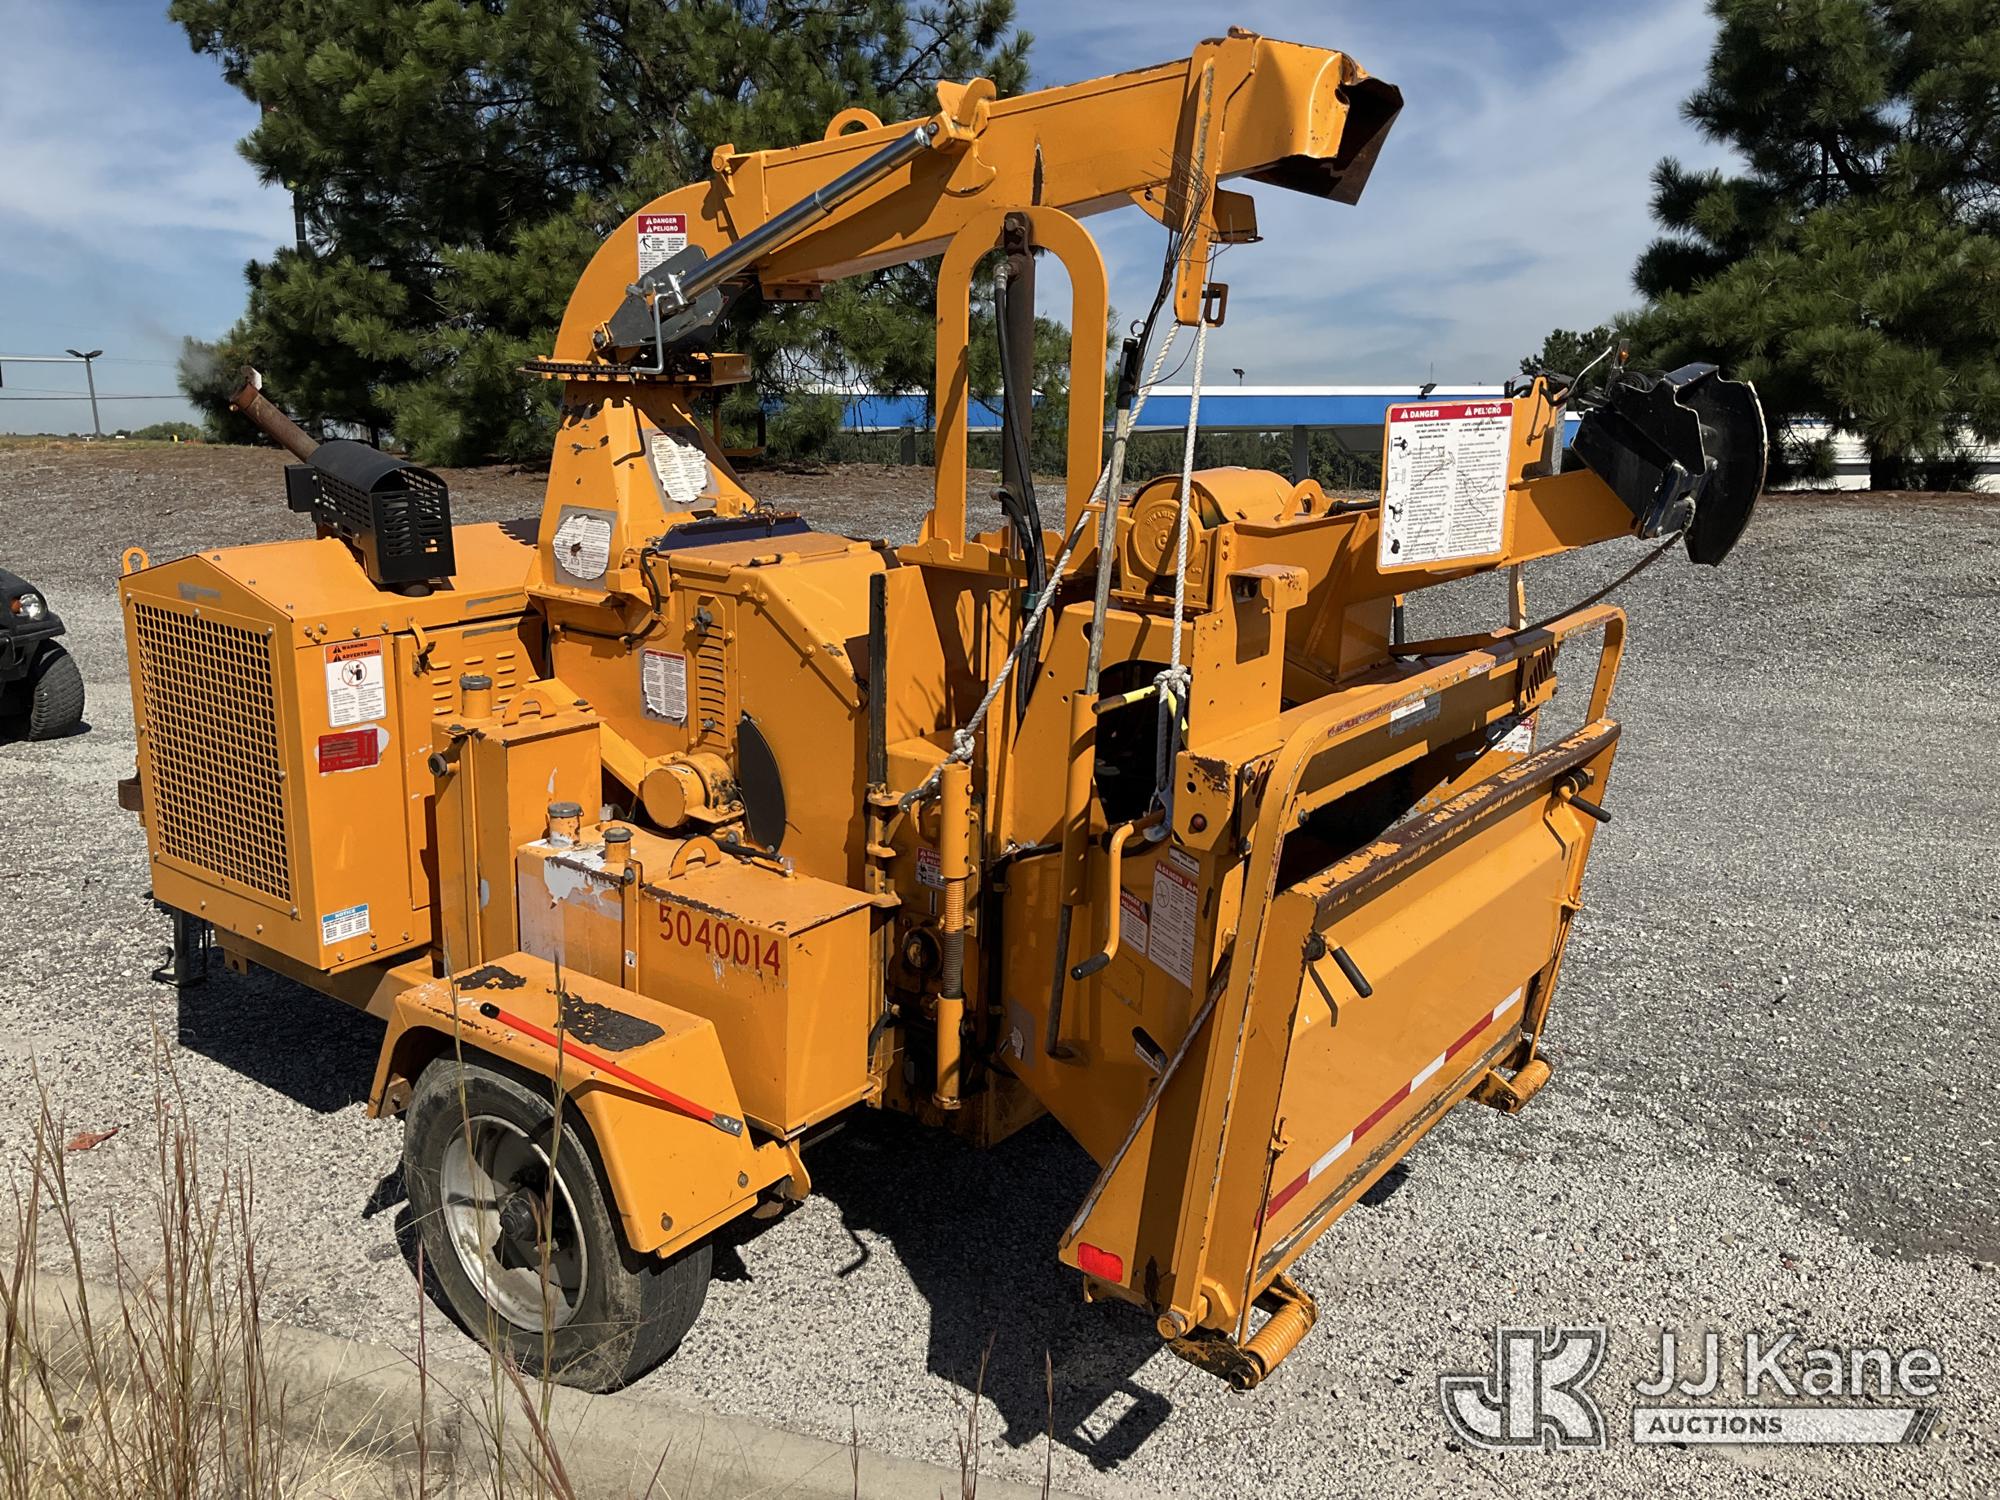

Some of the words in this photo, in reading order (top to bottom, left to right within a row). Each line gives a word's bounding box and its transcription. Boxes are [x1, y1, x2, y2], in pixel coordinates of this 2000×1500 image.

[1409, 409, 1439, 419] DANGER
[341, 642, 368, 650] WARNING
[341, 649, 380, 659] ADVERTENCIA
[659, 904, 780, 977] 5040014
